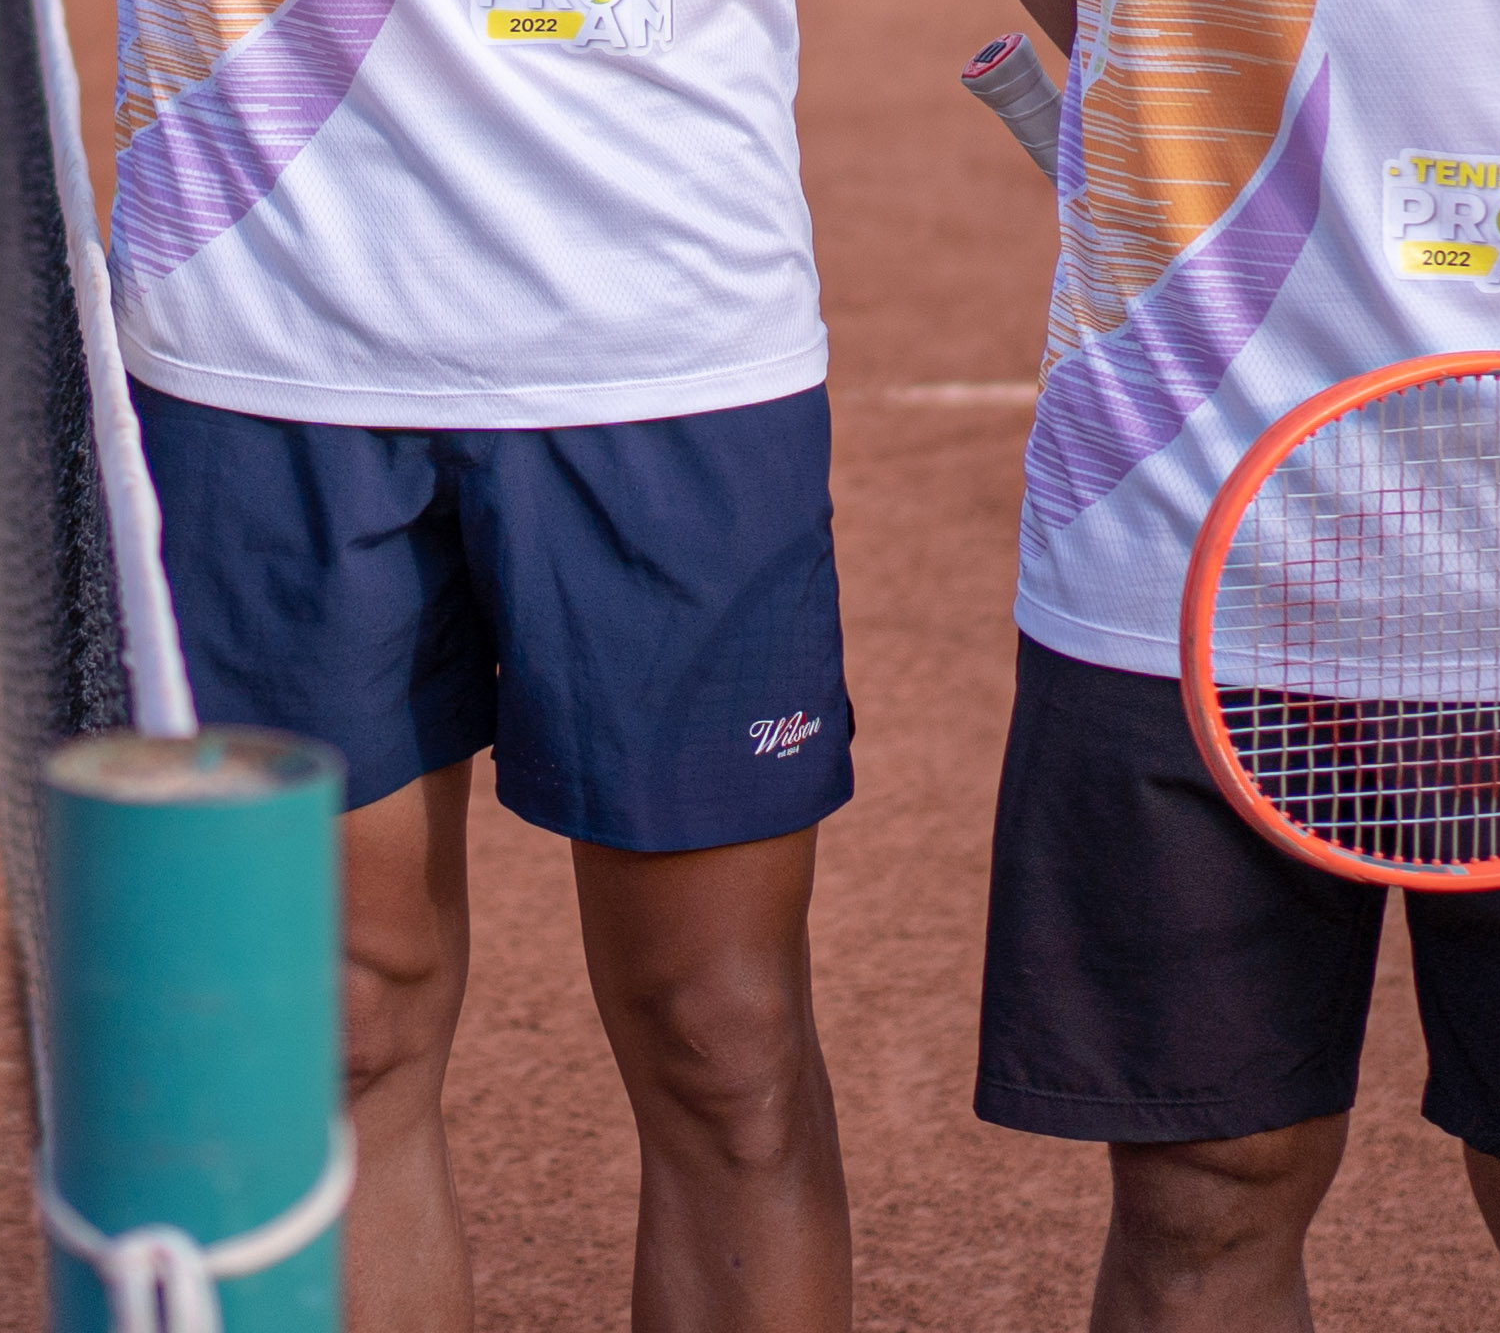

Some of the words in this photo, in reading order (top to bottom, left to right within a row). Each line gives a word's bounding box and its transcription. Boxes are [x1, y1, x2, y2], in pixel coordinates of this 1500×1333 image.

[509, 17, 558, 33] 2022
[1421, 249, 1472, 268] 2022
[749, 710, 821, 755] Wilson
